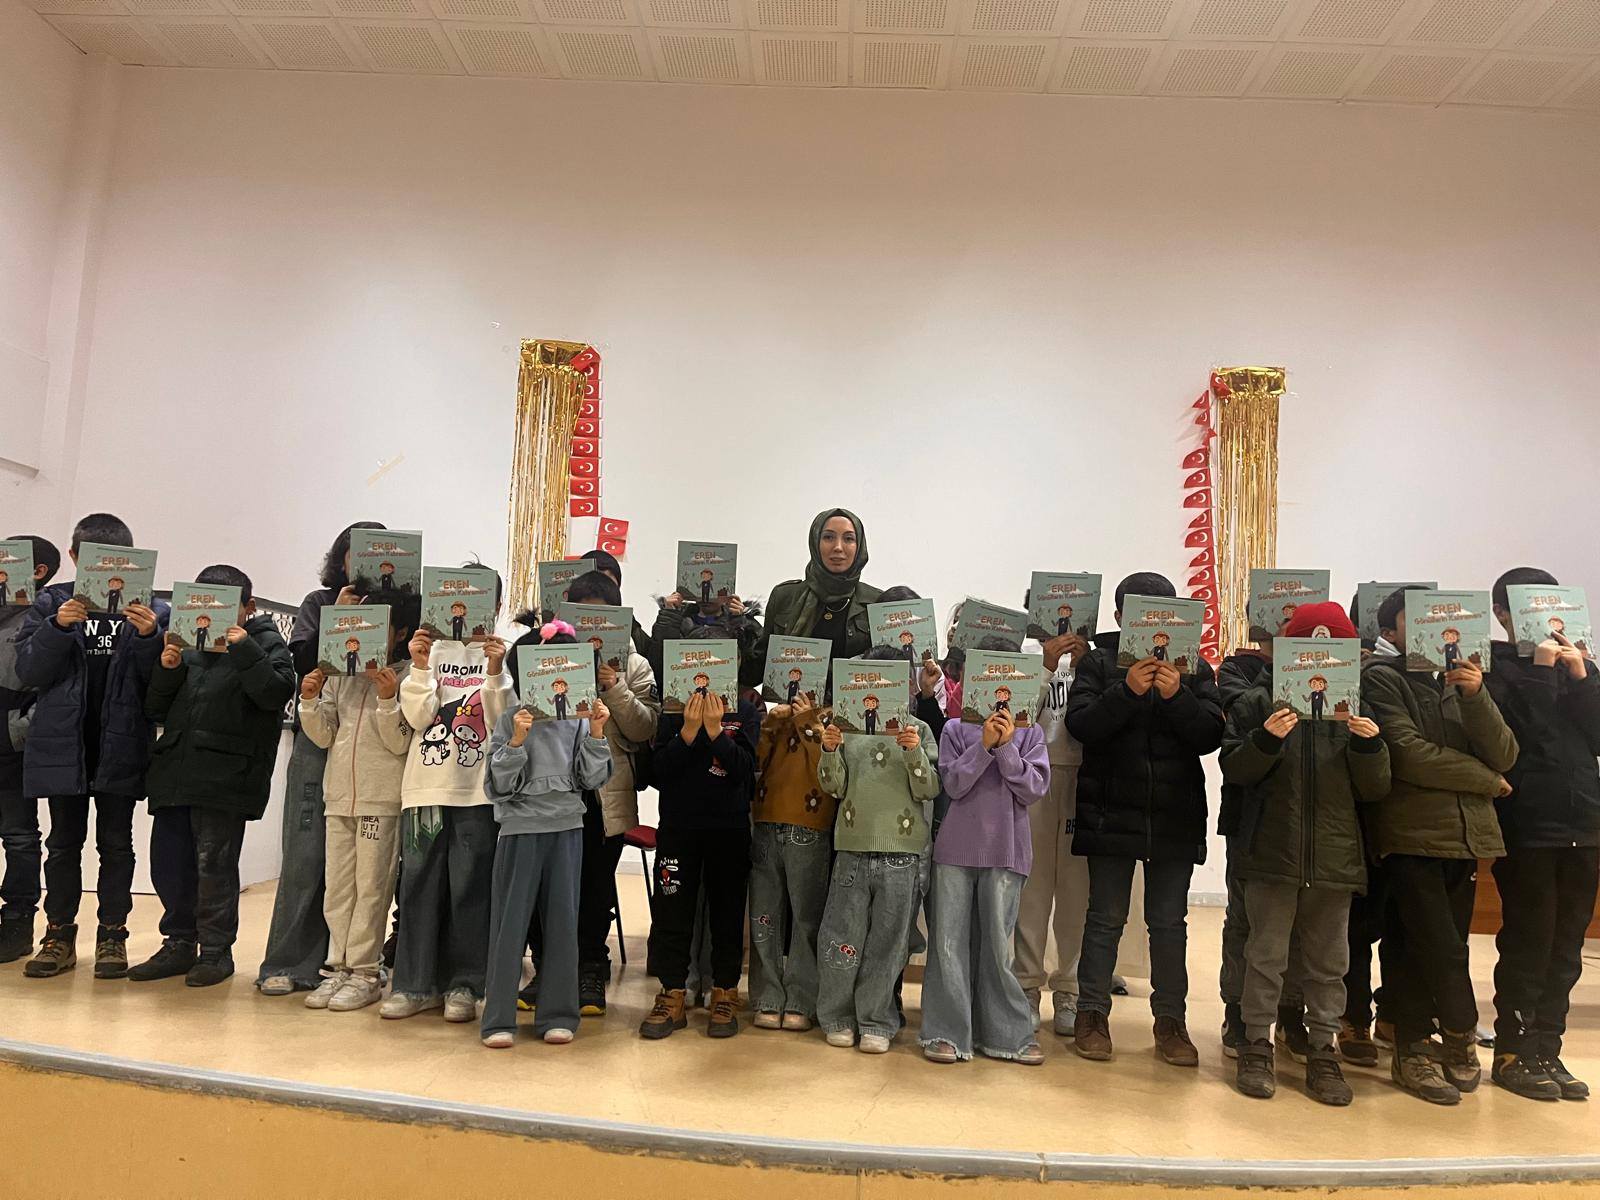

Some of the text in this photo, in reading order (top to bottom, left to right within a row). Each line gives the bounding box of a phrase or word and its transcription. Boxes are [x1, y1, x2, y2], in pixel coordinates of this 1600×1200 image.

[372, 542, 397, 550] EREN
[694, 551, 716, 560] EREN
[554, 570, 574, 579] EREN
[443, 580, 469, 589] EREN
[1051, 583, 1077, 593] EREN
[1273, 580, 1302, 591] EREN
[191, 594, 216, 603] EREN
[1432, 603, 1461, 614] EREN
[889, 610, 912, 621] EREN
[1146, 610, 1175, 620] EREN
[339, 615, 362, 626] EREN
[580, 616, 607, 624] EREN
[981, 616, 1005, 625] EREN
[98, 635, 112, 648] 36
[685, 650, 711, 661] EREN
[784, 647, 807, 656] EREN
[1299, 650, 1329, 662] EREN
[541, 655, 568, 667] EREN
[987, 664, 1016, 673] EREN
[854, 672, 881, 682] EREN
[362, 824, 379, 832] UTI
[361, 832, 380, 841] FUL
